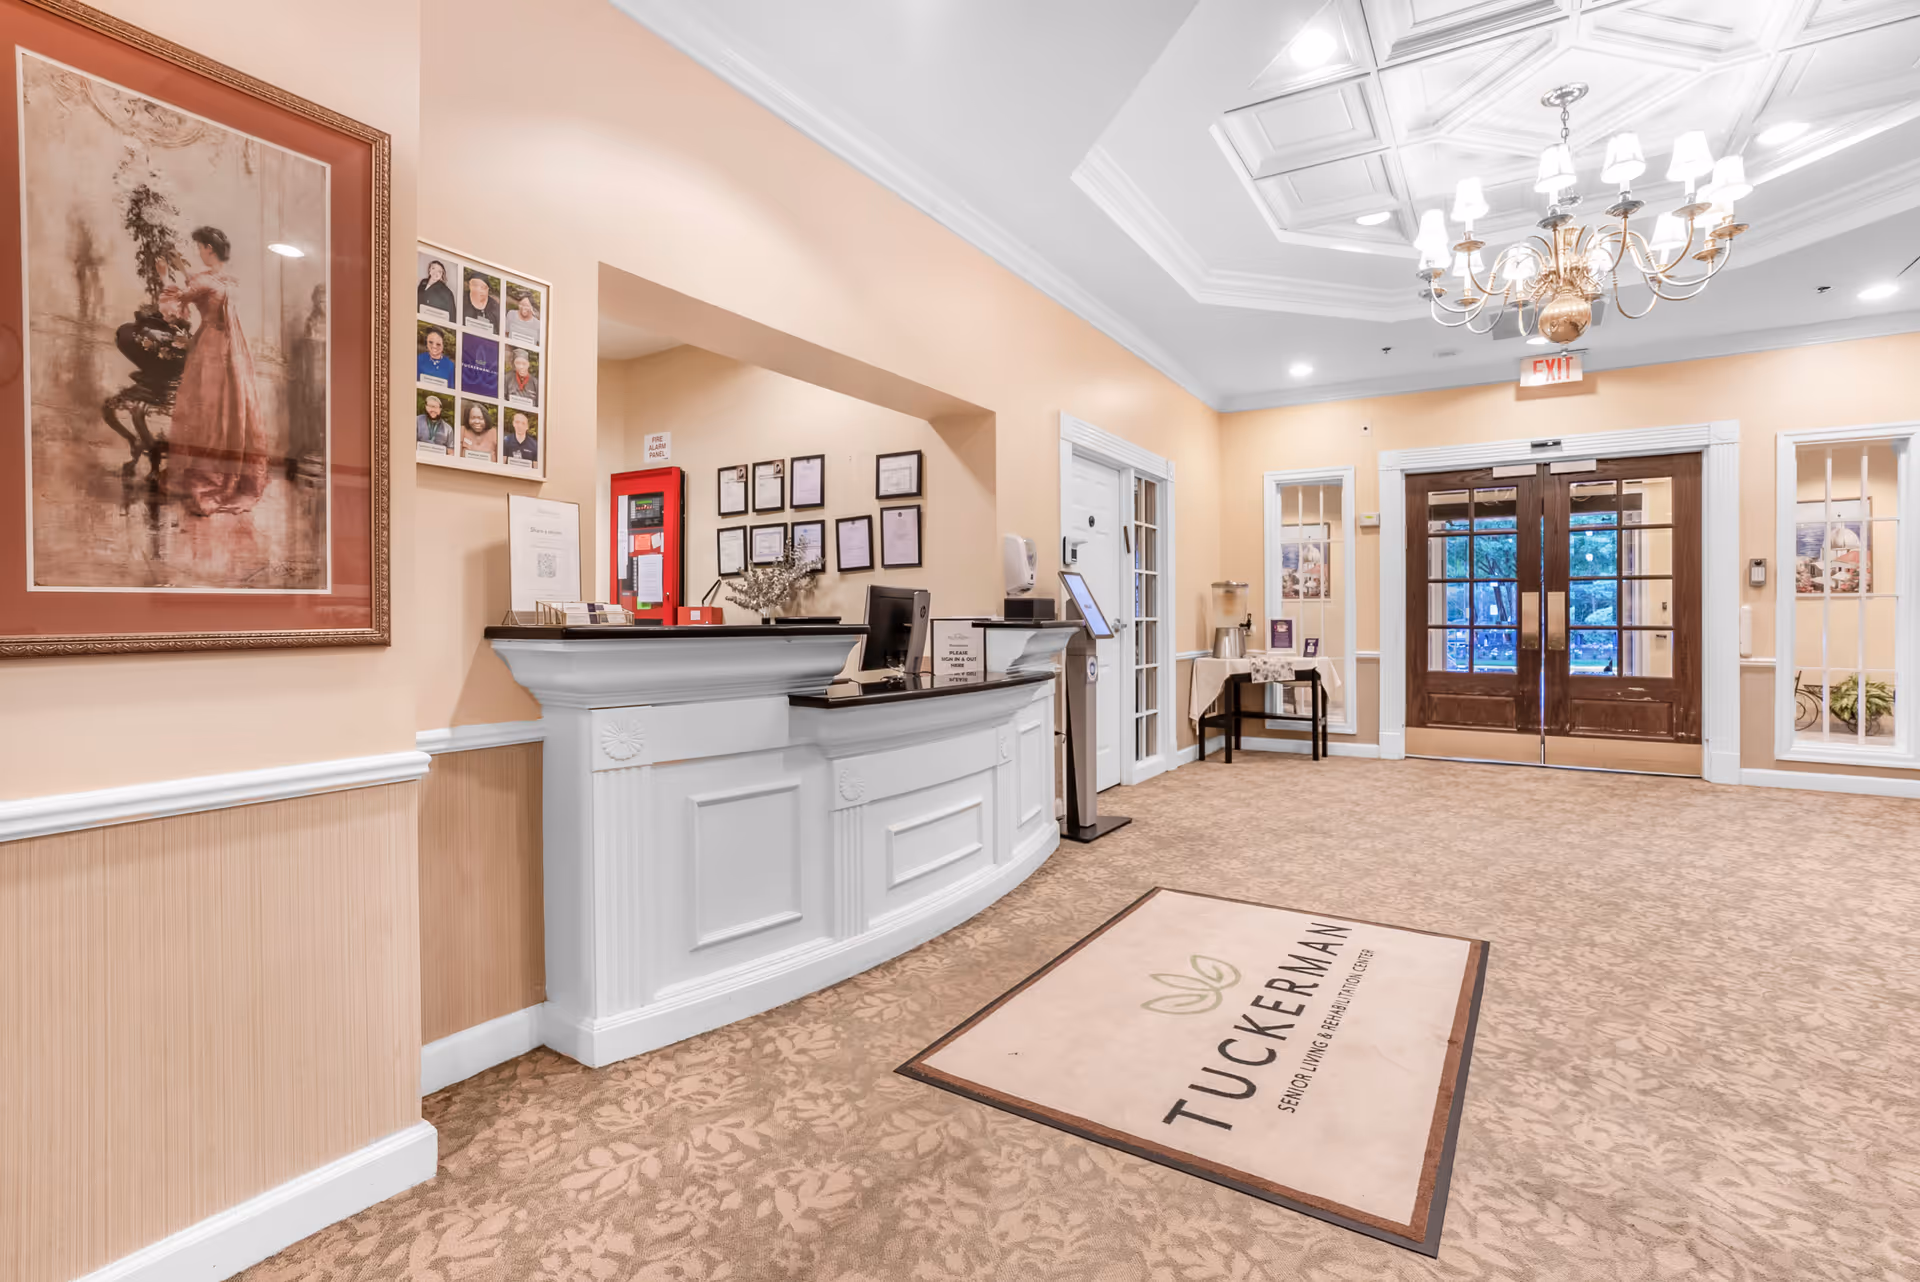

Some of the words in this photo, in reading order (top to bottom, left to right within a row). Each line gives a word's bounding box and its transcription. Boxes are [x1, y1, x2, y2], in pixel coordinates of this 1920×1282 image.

[1533, 356, 1573, 382] EXIT
[649, 443, 667, 451] ALARM
[1352, 949, 1374, 973] CENTER
[1321, 975, 1360, 1031] REHABILITATION
[1162, 922, 1352, 1131] TUCKERMAN
[1317, 1032, 1333, 1040] &
[1300, 1041, 1329, 1072] LIVING
[1277, 1073, 1313, 1113] SENIOR
